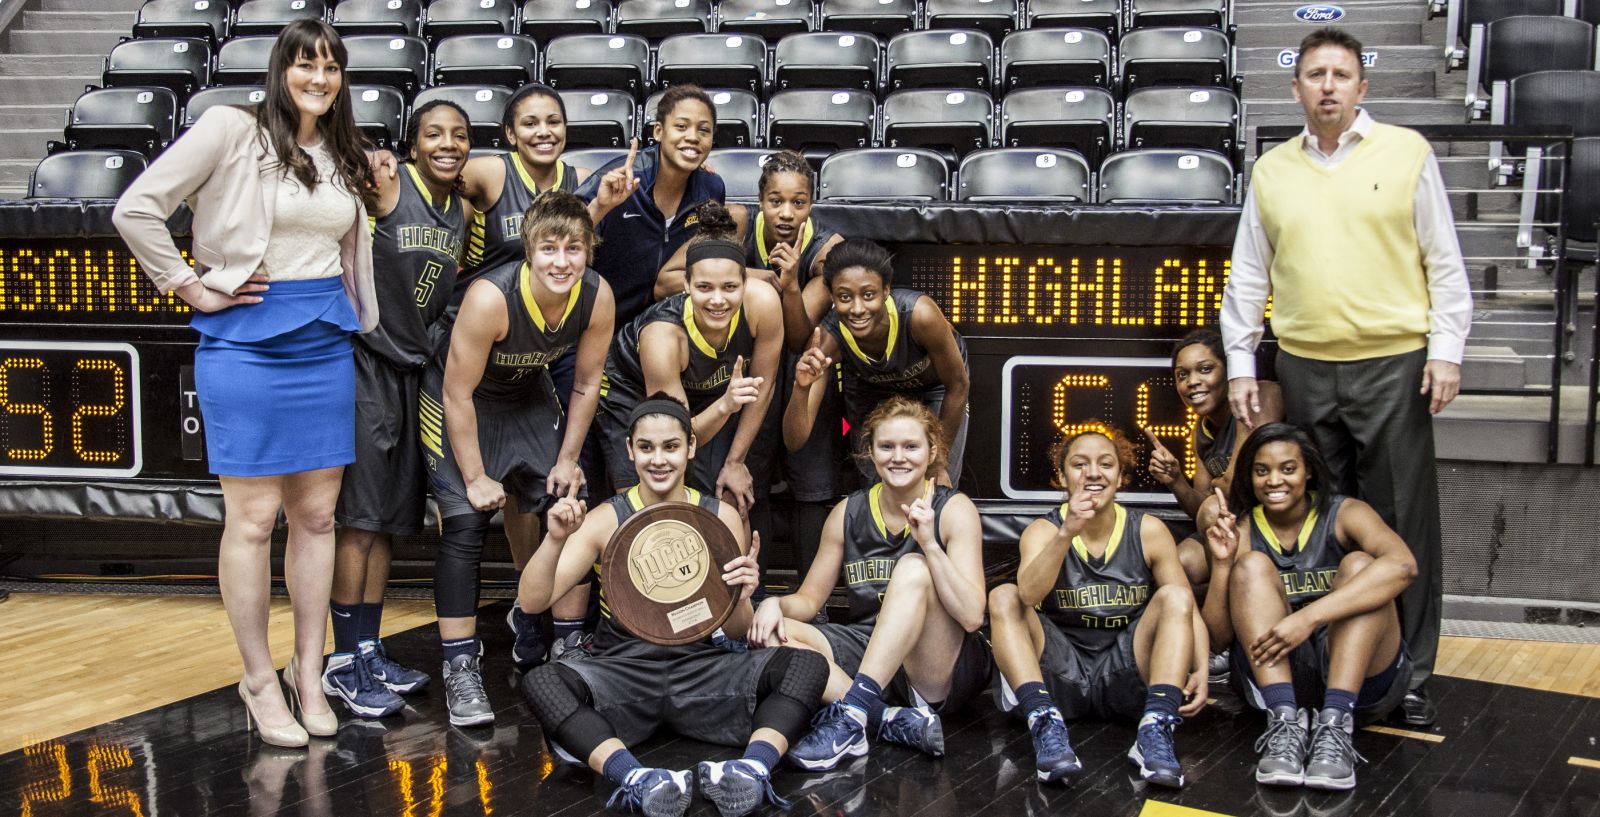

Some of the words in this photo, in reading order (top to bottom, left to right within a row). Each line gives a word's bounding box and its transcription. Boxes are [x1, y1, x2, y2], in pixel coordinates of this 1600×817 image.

[1303, 7, 1334, 20] Ford
[414, 260, 443, 308] 5
[0, 357, 125, 463] 52
[632, 531, 703, 594] NJCAA
[679, 565, 692, 576] VI
